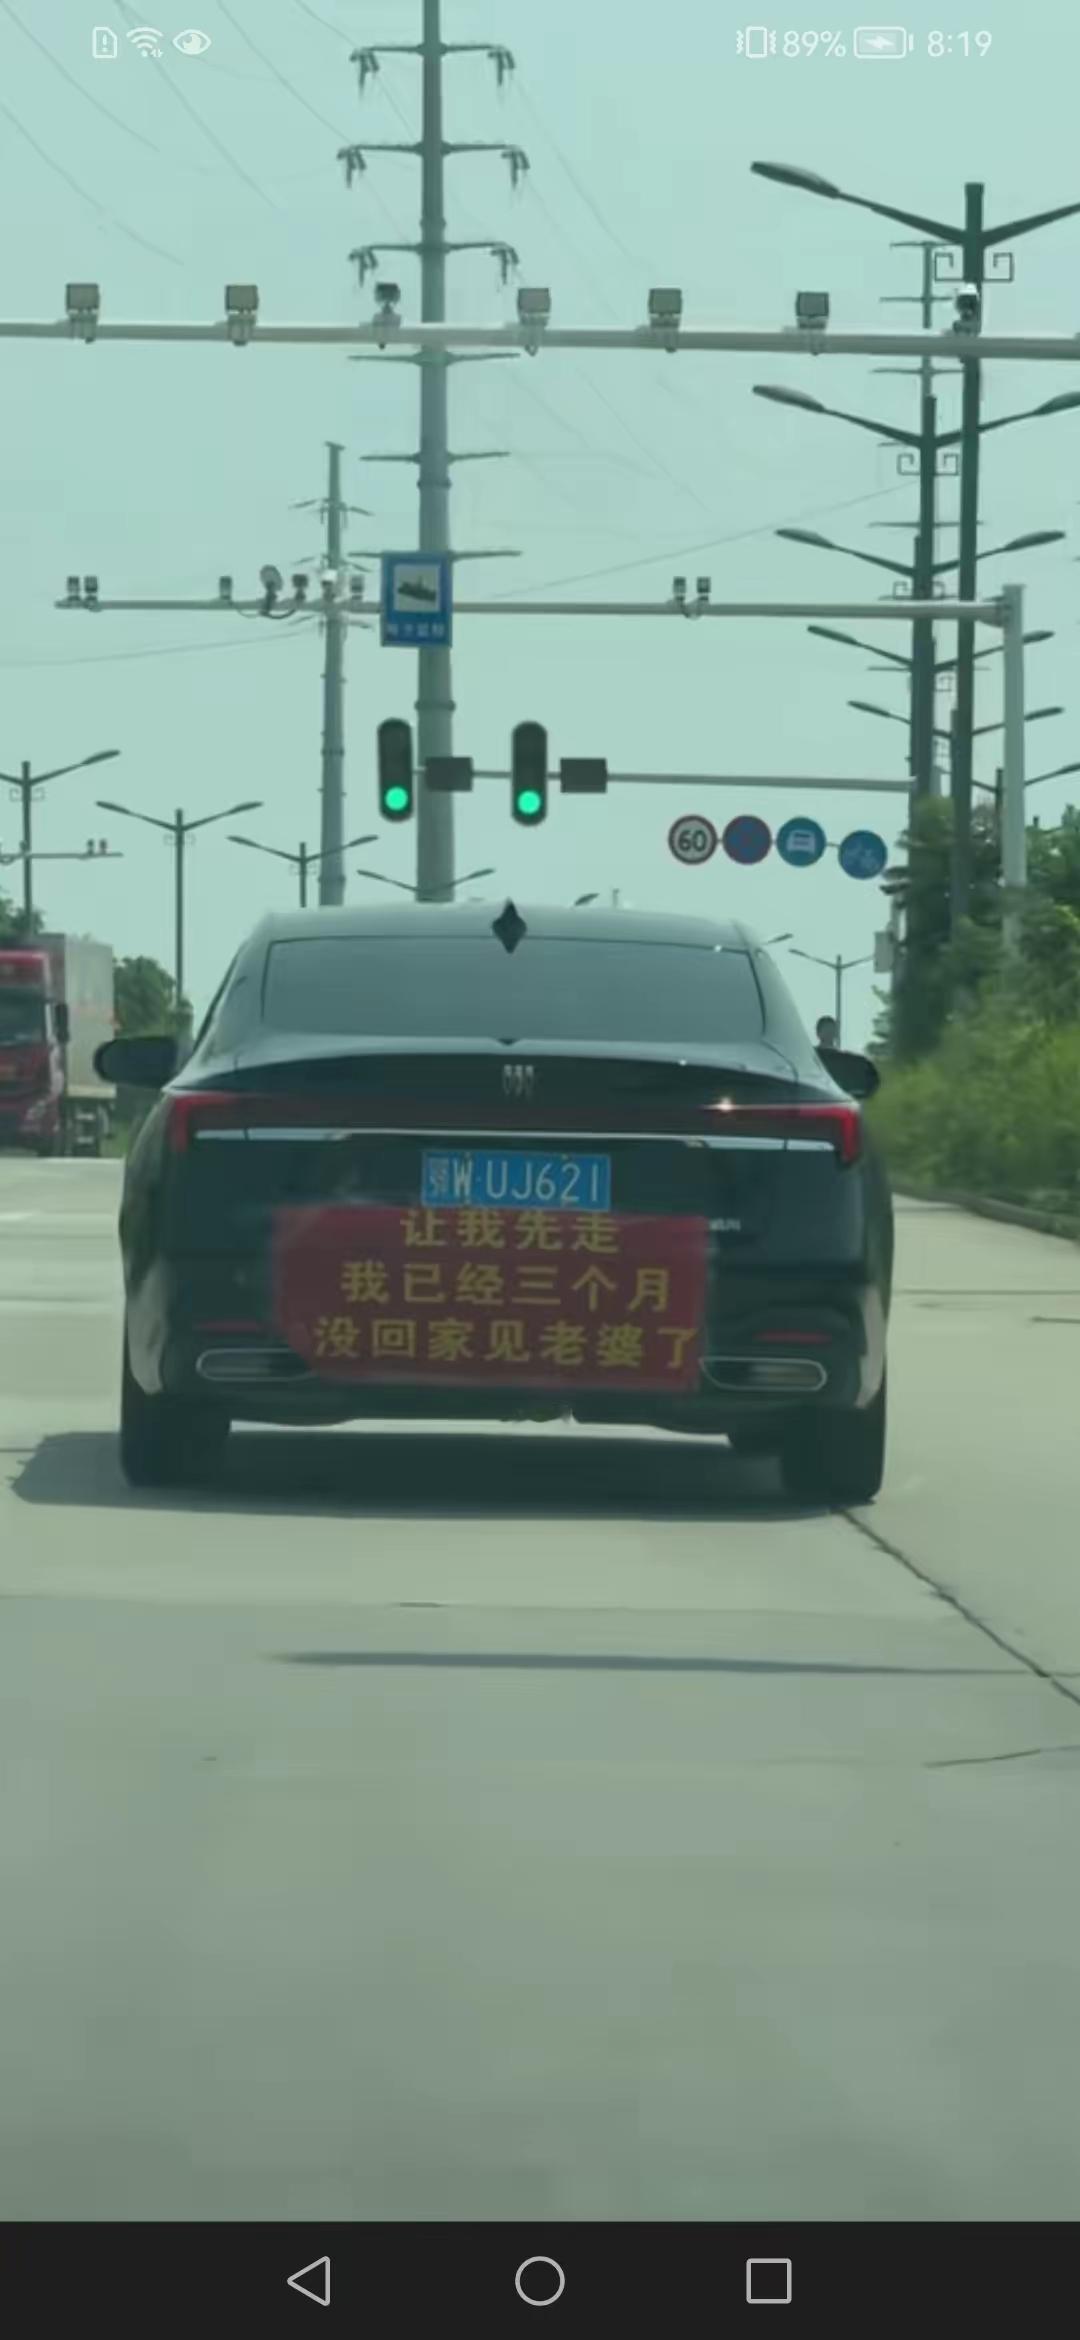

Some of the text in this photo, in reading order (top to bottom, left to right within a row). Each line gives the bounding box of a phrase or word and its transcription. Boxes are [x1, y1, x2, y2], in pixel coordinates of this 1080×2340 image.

[677, 829, 708, 852] 60
[399, 1207, 621, 1255] 让我先走
[339, 1258, 671, 1313] 我已经三个月
[312, 1316, 698, 1370] 没回家见老婆了
